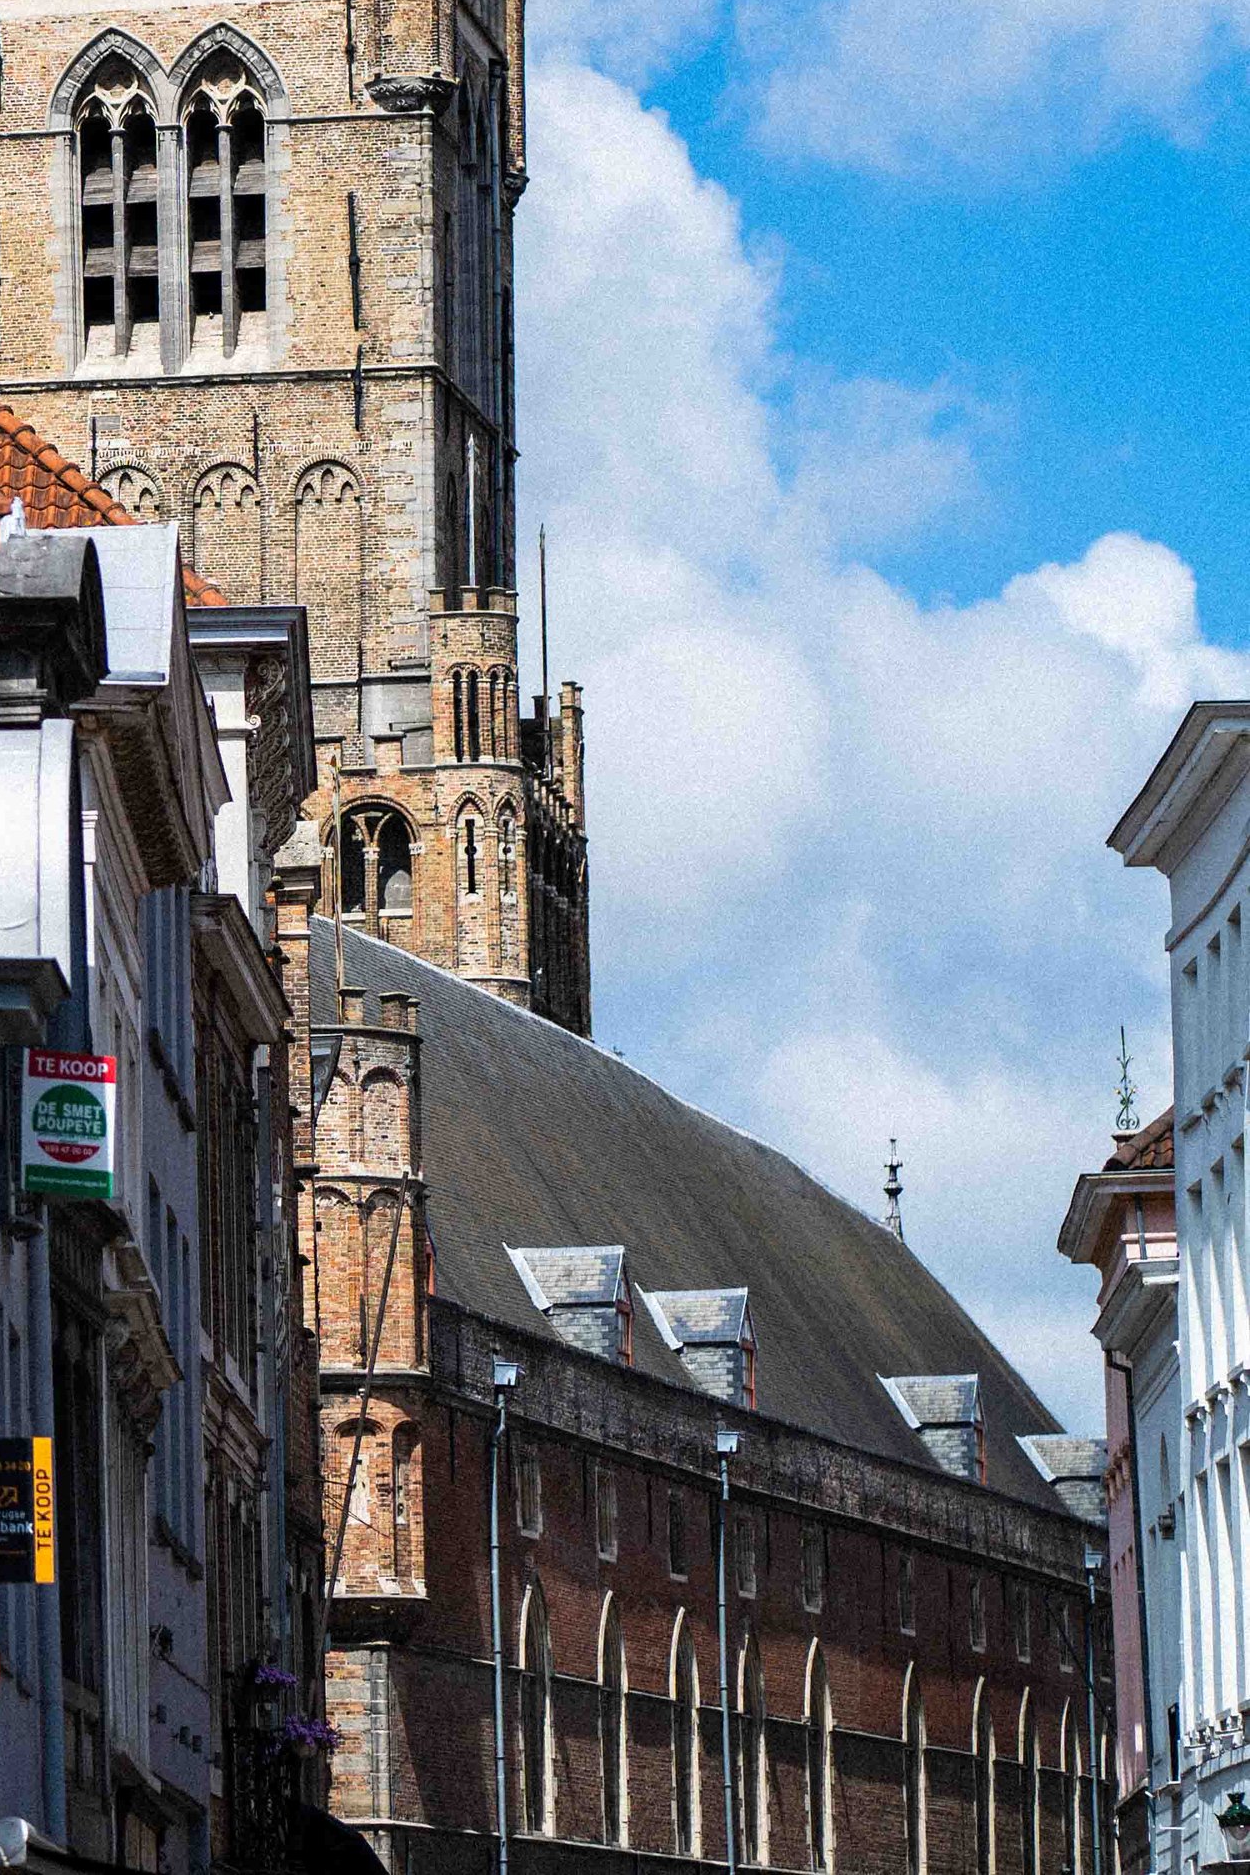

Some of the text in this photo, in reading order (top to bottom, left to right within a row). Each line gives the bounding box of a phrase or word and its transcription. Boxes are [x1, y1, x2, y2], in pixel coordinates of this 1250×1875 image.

[35, 1056, 109, 1078] TE KOOP
[38, 1101, 101, 1120] DE SMET
[37, 1116, 101, 1134] POUPEYE
[36, 1468, 51, 1551] TE KOOP
